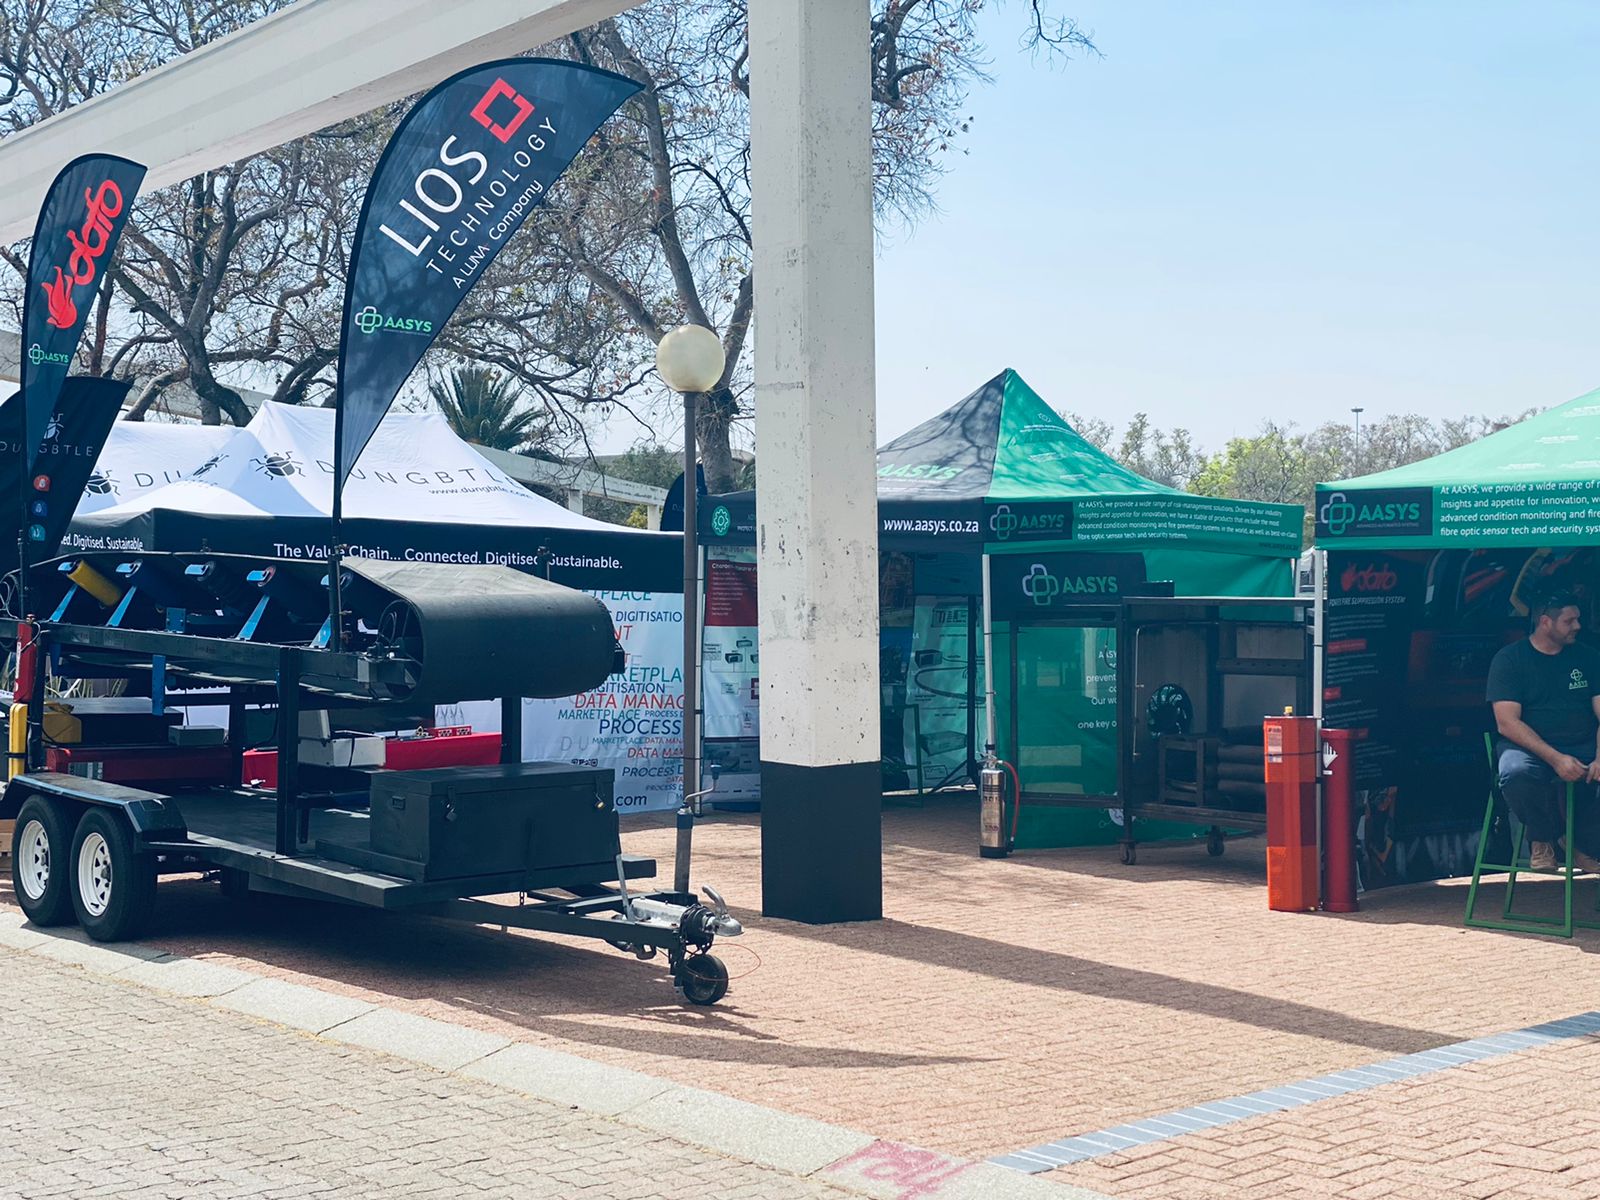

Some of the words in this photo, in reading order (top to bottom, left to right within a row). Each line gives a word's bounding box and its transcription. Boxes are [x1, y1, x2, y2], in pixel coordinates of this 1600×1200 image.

[379, 135, 488, 256] LIOS
[426, 117, 557, 275] TECHNOLOGY
[453, 275, 466, 289] A
[460, 243, 491, 277] LUNA
[488, 180, 543, 241] Company
[384, 315, 433, 333] AASYS
[0, 441, 94, 457] DUGBTLE
[878, 464, 964, 480] AASYS
[1441, 486, 1449, 494] At
[1452, 485, 1479, 494] AASYS,
[1496, 483, 1526, 494] provide
[1536, 481, 1556, 490] wide
[1559, 482, 1582, 492] range
[1586, 480, 1595, 489] of
[1114, 501, 1133, 509] provide
[1441, 500, 1472, 510] insights
[1474, 499, 1489, 508] and
[1491, 498, 1525, 508] appetite
[1528, 497, 1539, 506] for
[1542, 496, 1590, 505] innovation,
[1358, 503, 1420, 521] AASYS
[1440, 513, 1478, 522] advanced
[1480, 512, 1518, 522] condition
[1520, 510, 1567, 521] monitoring
[1569, 510, 1585, 518] and
[883, 519, 979, 535] www.aasys.co.za
[1020, 514, 1065, 529] AASYS
[1440, 527, 1458, 536] fibre
[1460, 526, 1480, 537] optic
[1482, 528, 1509, 536] sensor
[1511, 526, 1529, 534] tech
[1532, 525, 1548, 534] and
[1550, 524, 1583, 536] security
[73, 534, 106, 551] Digitised.
[274, 544, 302, 558] The
[349, 546, 401, 561] Chain...
[404, 549, 482, 564] Connected.
[549, 553, 623, 569] Sustainable.
[1062, 576, 1118, 593] AASYS
[575, 694, 618, 710] DATA
[1091, 697, 1106, 705] Our
[558, 710, 640, 720] MARKETPLACE
[644, 710, 678, 718] PROCESS
[600, 720, 682, 735] PROCESS
[1078, 721, 1094, 729] one
[1096, 720, 1110, 729] key
[645, 737, 664, 745] DATA
[628, 748, 659, 758] DATA
[622, 766, 674, 777] PROCESS
